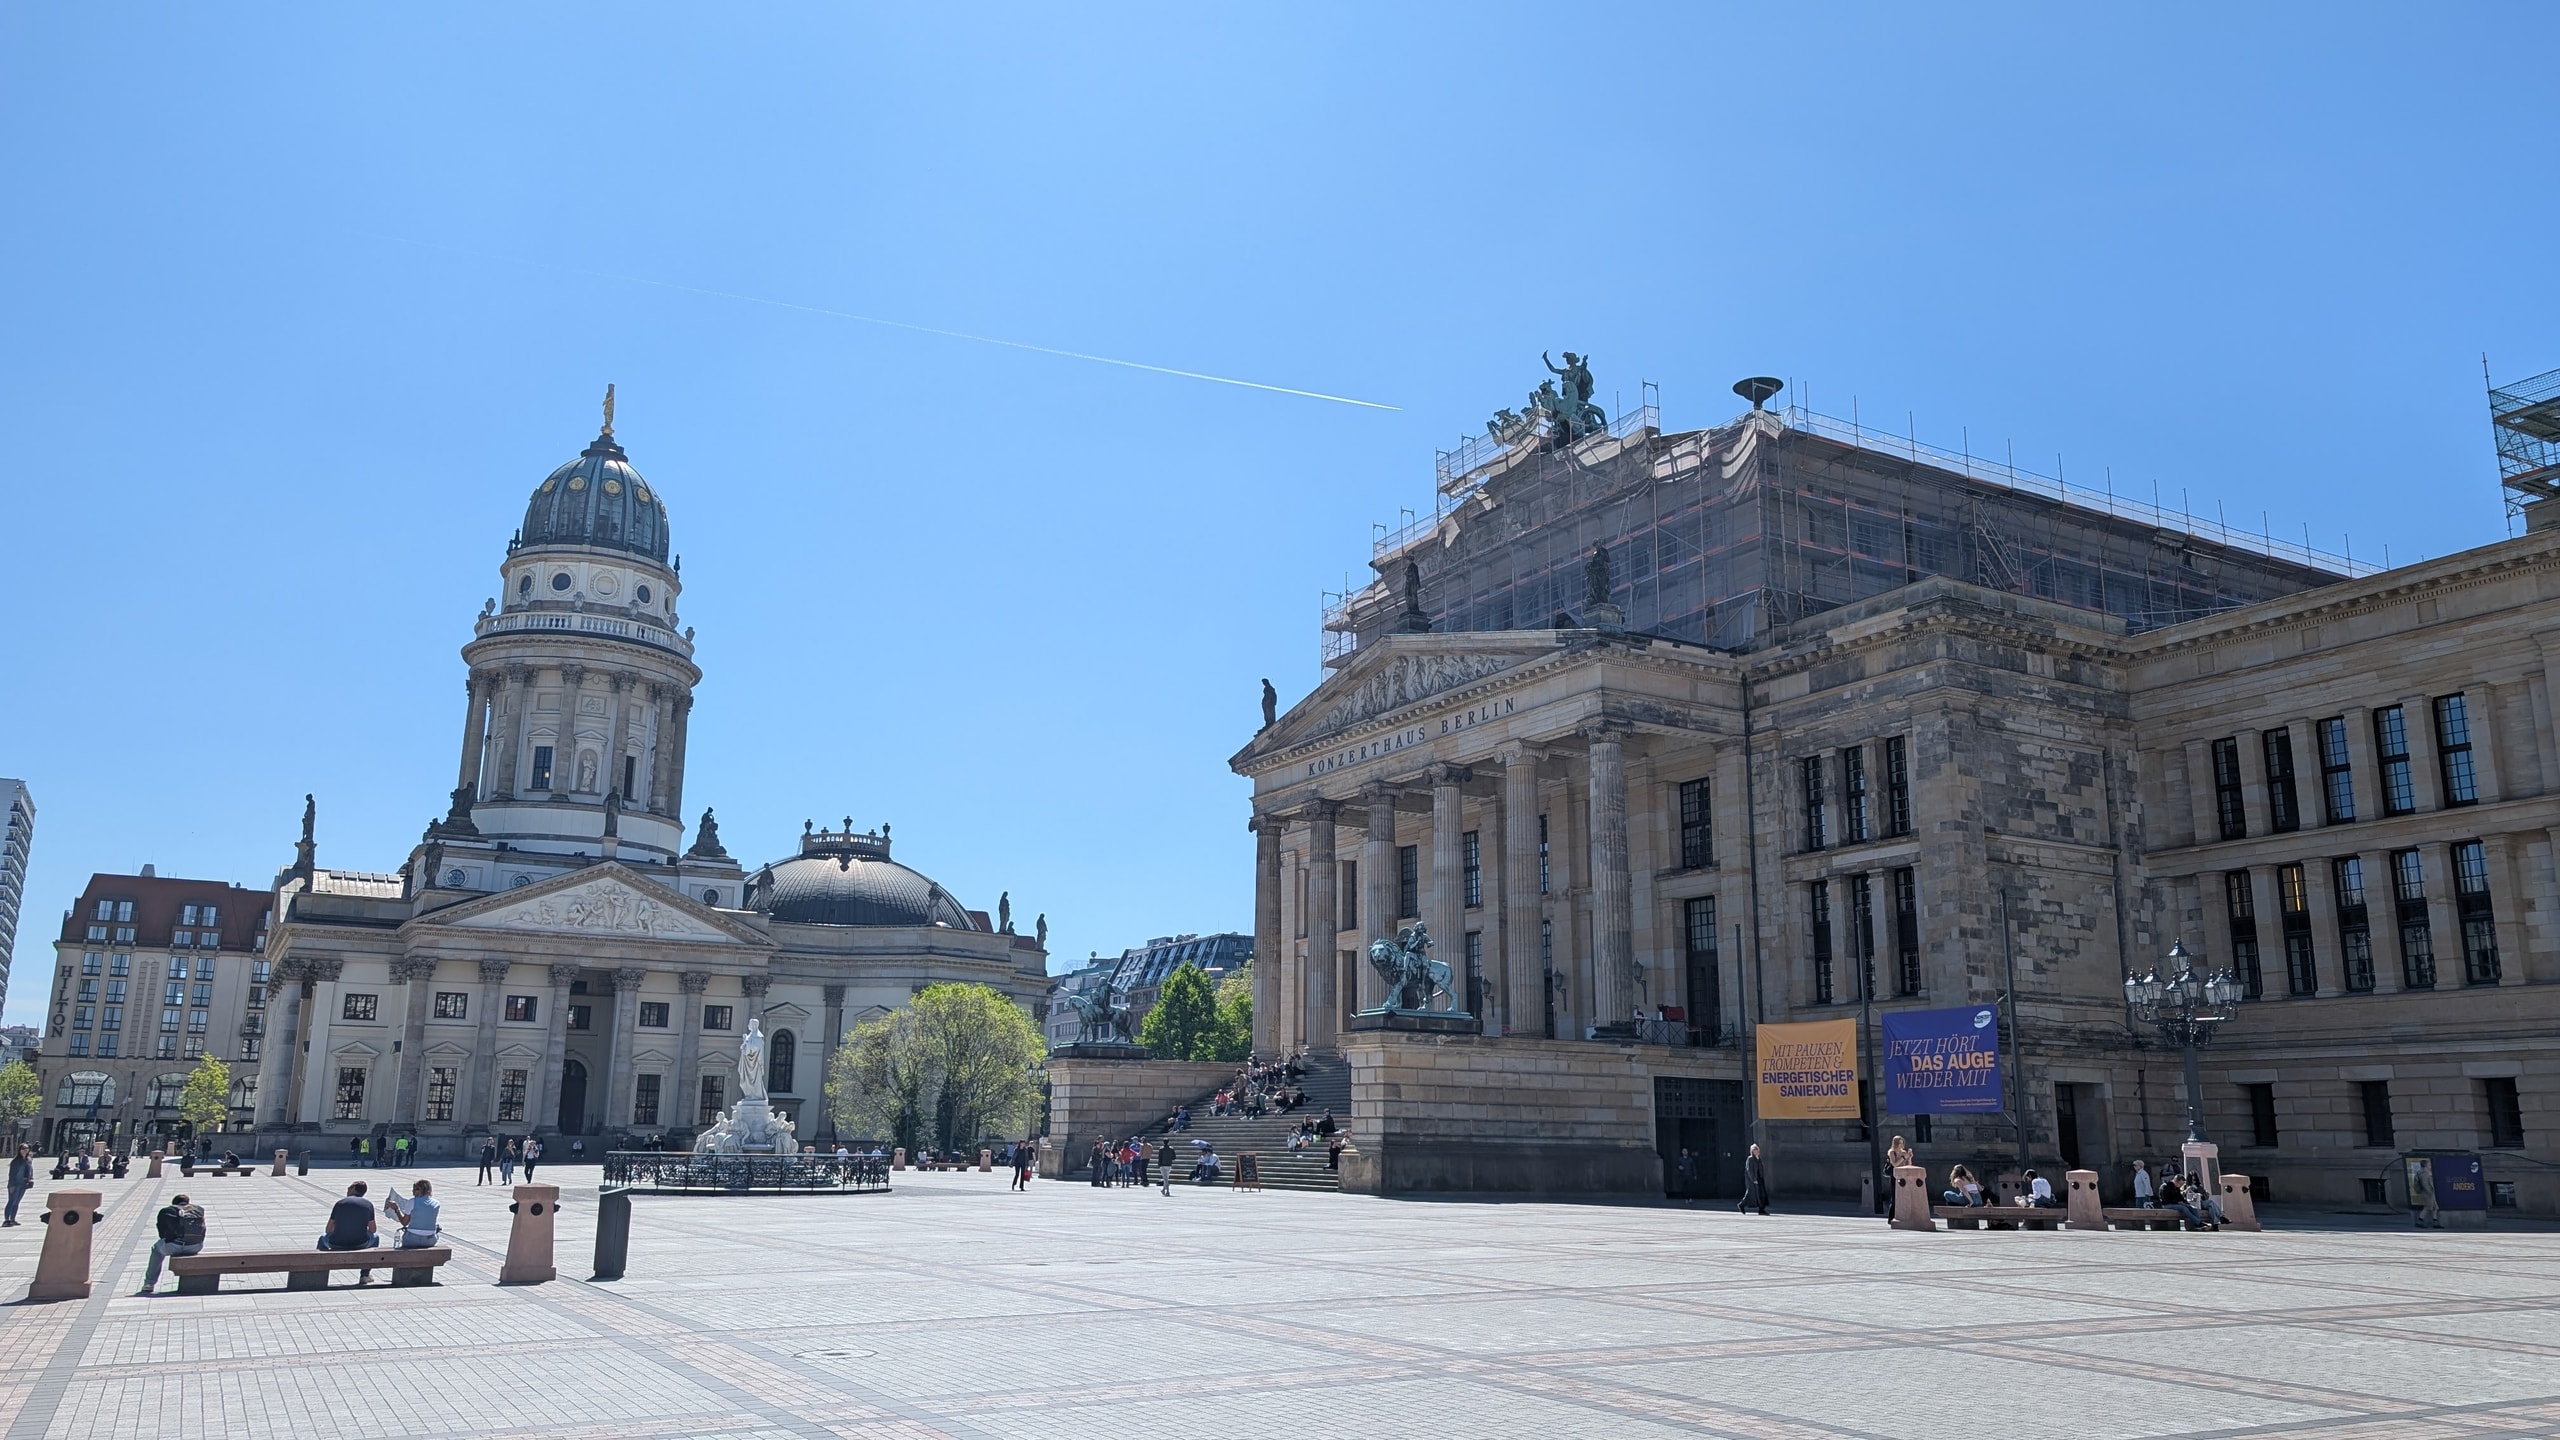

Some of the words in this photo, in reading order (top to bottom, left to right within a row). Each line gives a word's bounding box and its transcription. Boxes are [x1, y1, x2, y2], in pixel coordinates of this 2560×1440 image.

[1308, 726, 1425, 777] KONZERTHAUS
[1441, 697, 1516, 734] BERLIN
[51, 965, 74, 1037] HILTON
[1771, 1044, 1794, 1058] MIT
[1795, 1041, 1845, 1057] PAUKEN,
[1888, 1038, 1933, 1060] JETZT
[1934, 1033, 1980, 1054] HÖRT
[1762, 1056, 1832, 1071] TROMPETEN
[1833, 1055, 1844, 1069] &
[1911, 1054, 1944, 1072] DAS
[1947, 1051, 1995, 1070] AUGE
[1762, 1069, 1854, 1084] ENERGETISCHER
[1896, 1070, 1953, 1089] WIEDER
[1957, 1068, 1991, 1087] MIT
[1780, 1083, 1849, 1097] SANIERUNG
